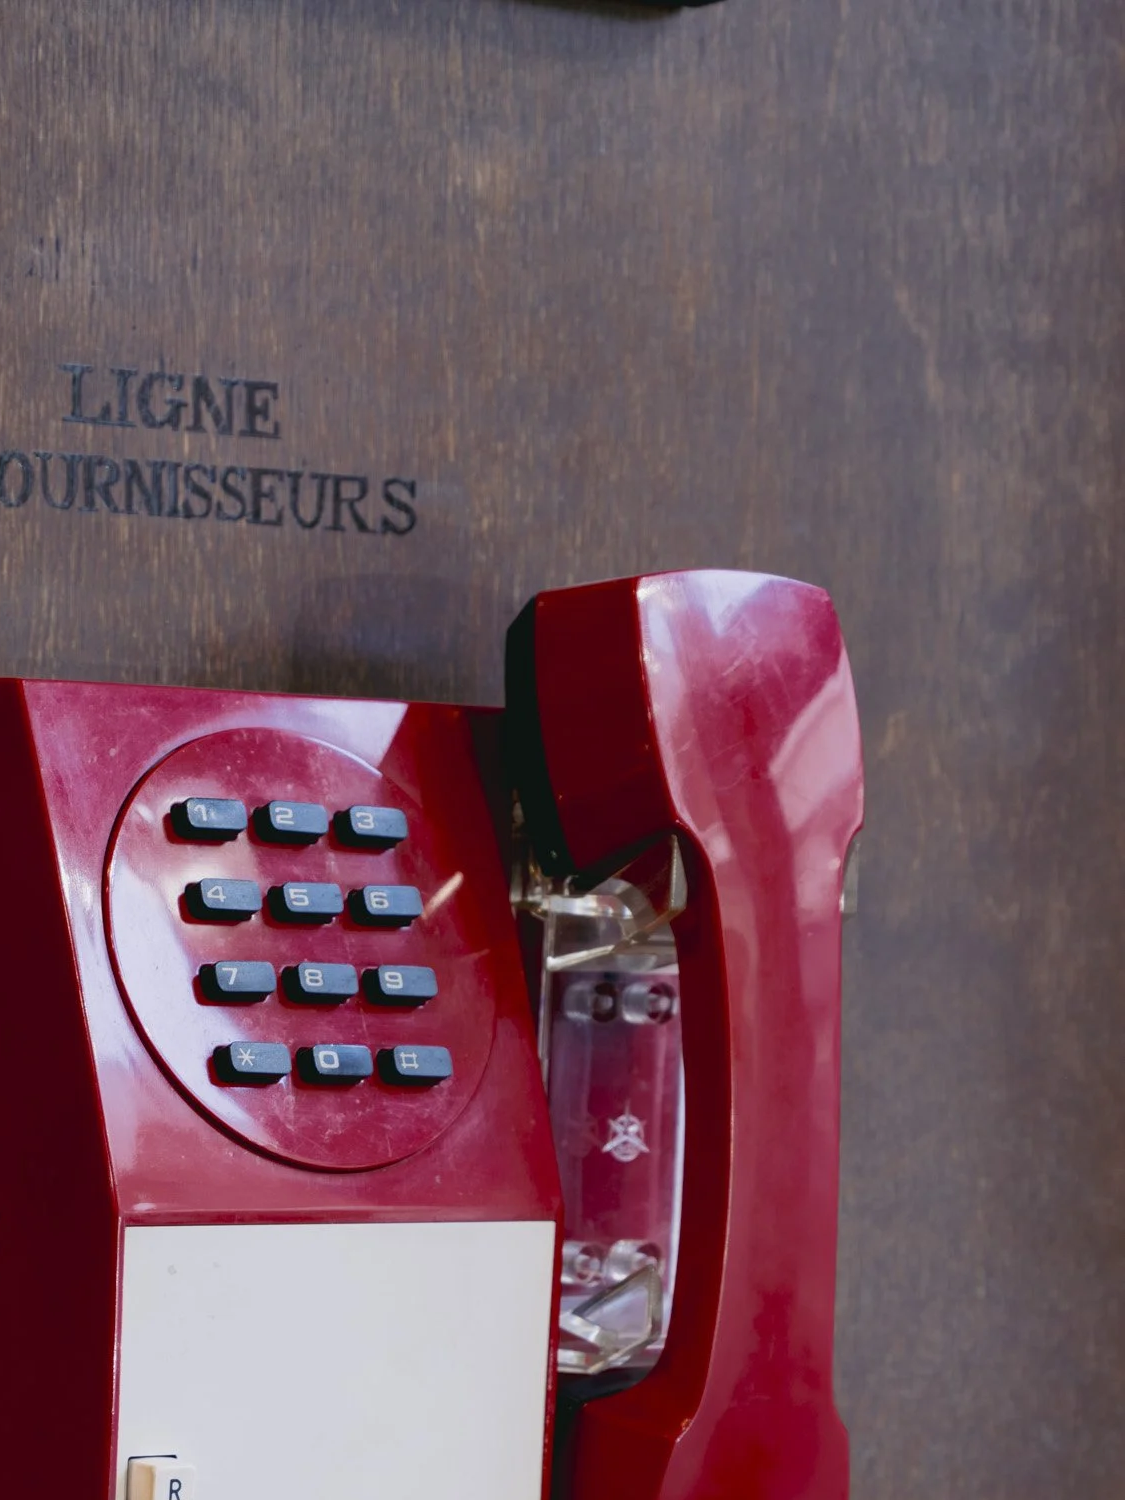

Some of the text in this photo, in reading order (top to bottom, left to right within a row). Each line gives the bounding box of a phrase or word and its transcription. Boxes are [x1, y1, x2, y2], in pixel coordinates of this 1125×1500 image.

[58, 363, 281, 439] LIGNE
[194, 804, 375, 829] 1 2 3
[206, 885, 389, 909] 4 5 6
[222, 967, 404, 989] 7 8 9
[318, 1050, 340, 1069] 0
